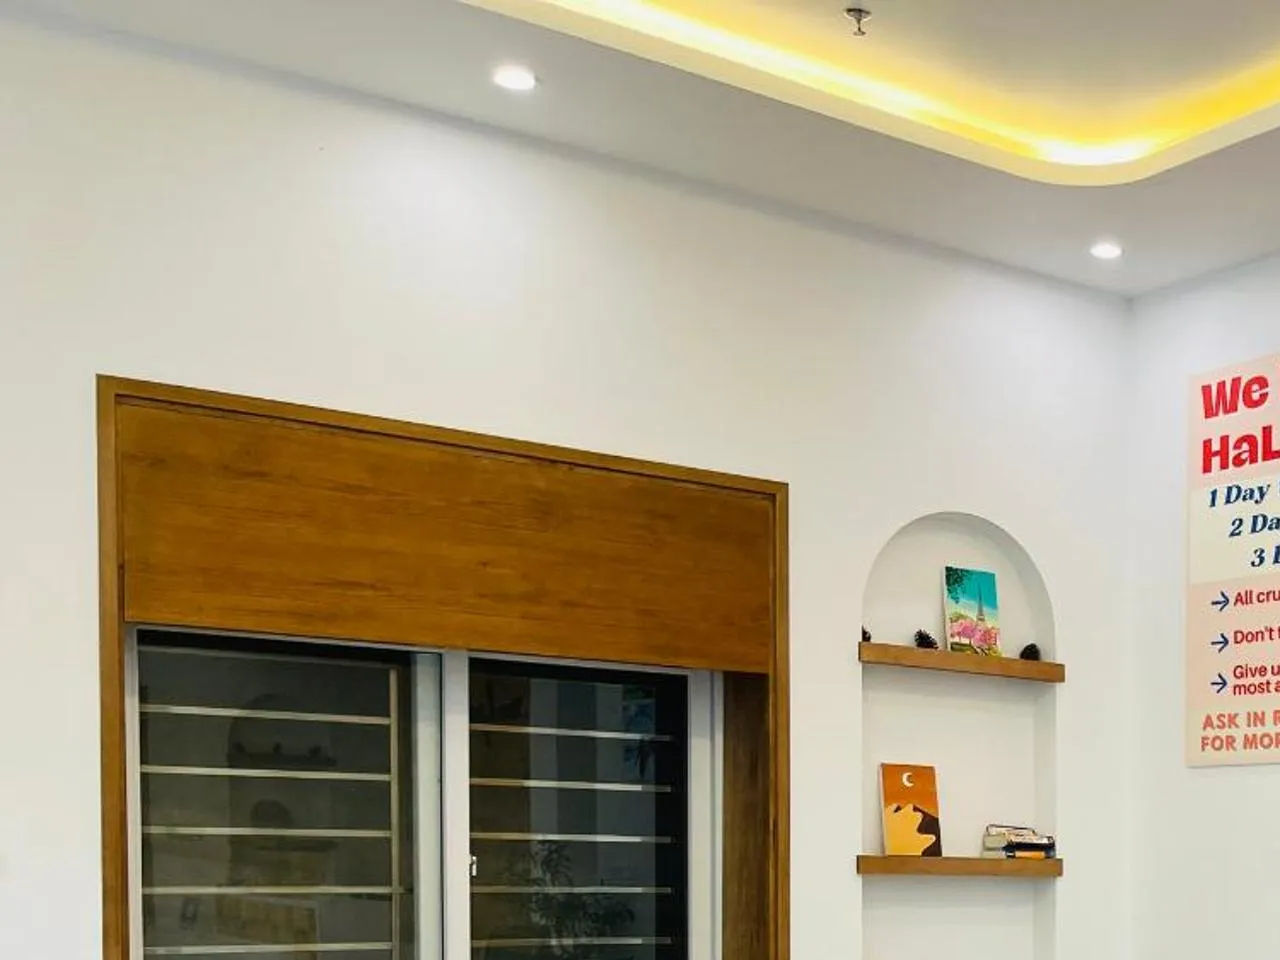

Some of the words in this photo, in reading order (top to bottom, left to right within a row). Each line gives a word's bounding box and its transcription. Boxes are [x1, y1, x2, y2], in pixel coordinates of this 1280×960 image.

[1201, 374, 1269, 419] We
[1209, 488, 1217, 507] 1
[1224, 482, 1270, 506] Day
[1228, 518, 1243, 538] 2
[1250, 548, 1265, 567] 3
[1233, 591, 1254, 607] All
[1233, 624, 1276, 645] Don't
[1233, 663, 1267, 680] Give
[1233, 680, 1272, 697] most
[1202, 711, 1240, 731] ASK
[1246, 710, 1265, 728] IN
[1200, 733, 1237, 752] FOR
